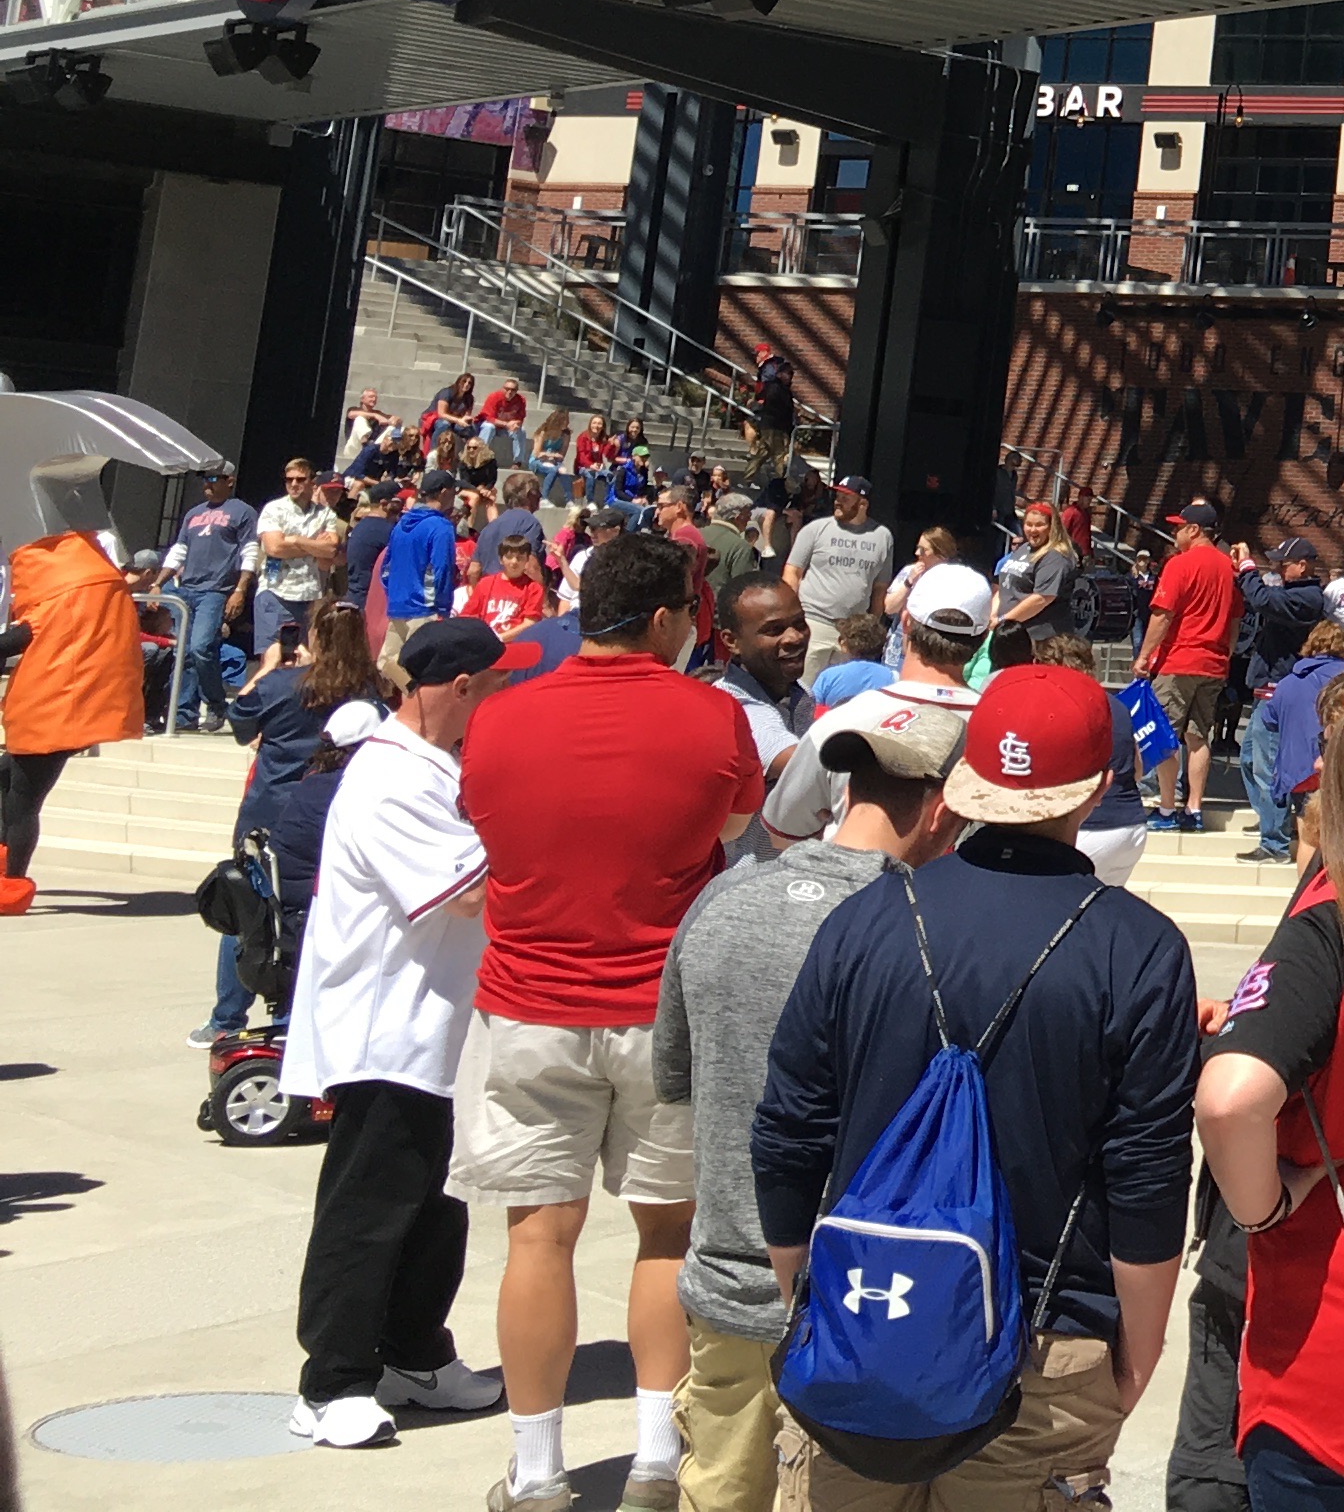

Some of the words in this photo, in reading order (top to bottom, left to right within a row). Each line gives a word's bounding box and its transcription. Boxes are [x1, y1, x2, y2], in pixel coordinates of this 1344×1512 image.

[1036, 85, 1123, 119] BAR
[831, 538, 858, 549] ROCK
[828, 555, 856, 568] CHOP
